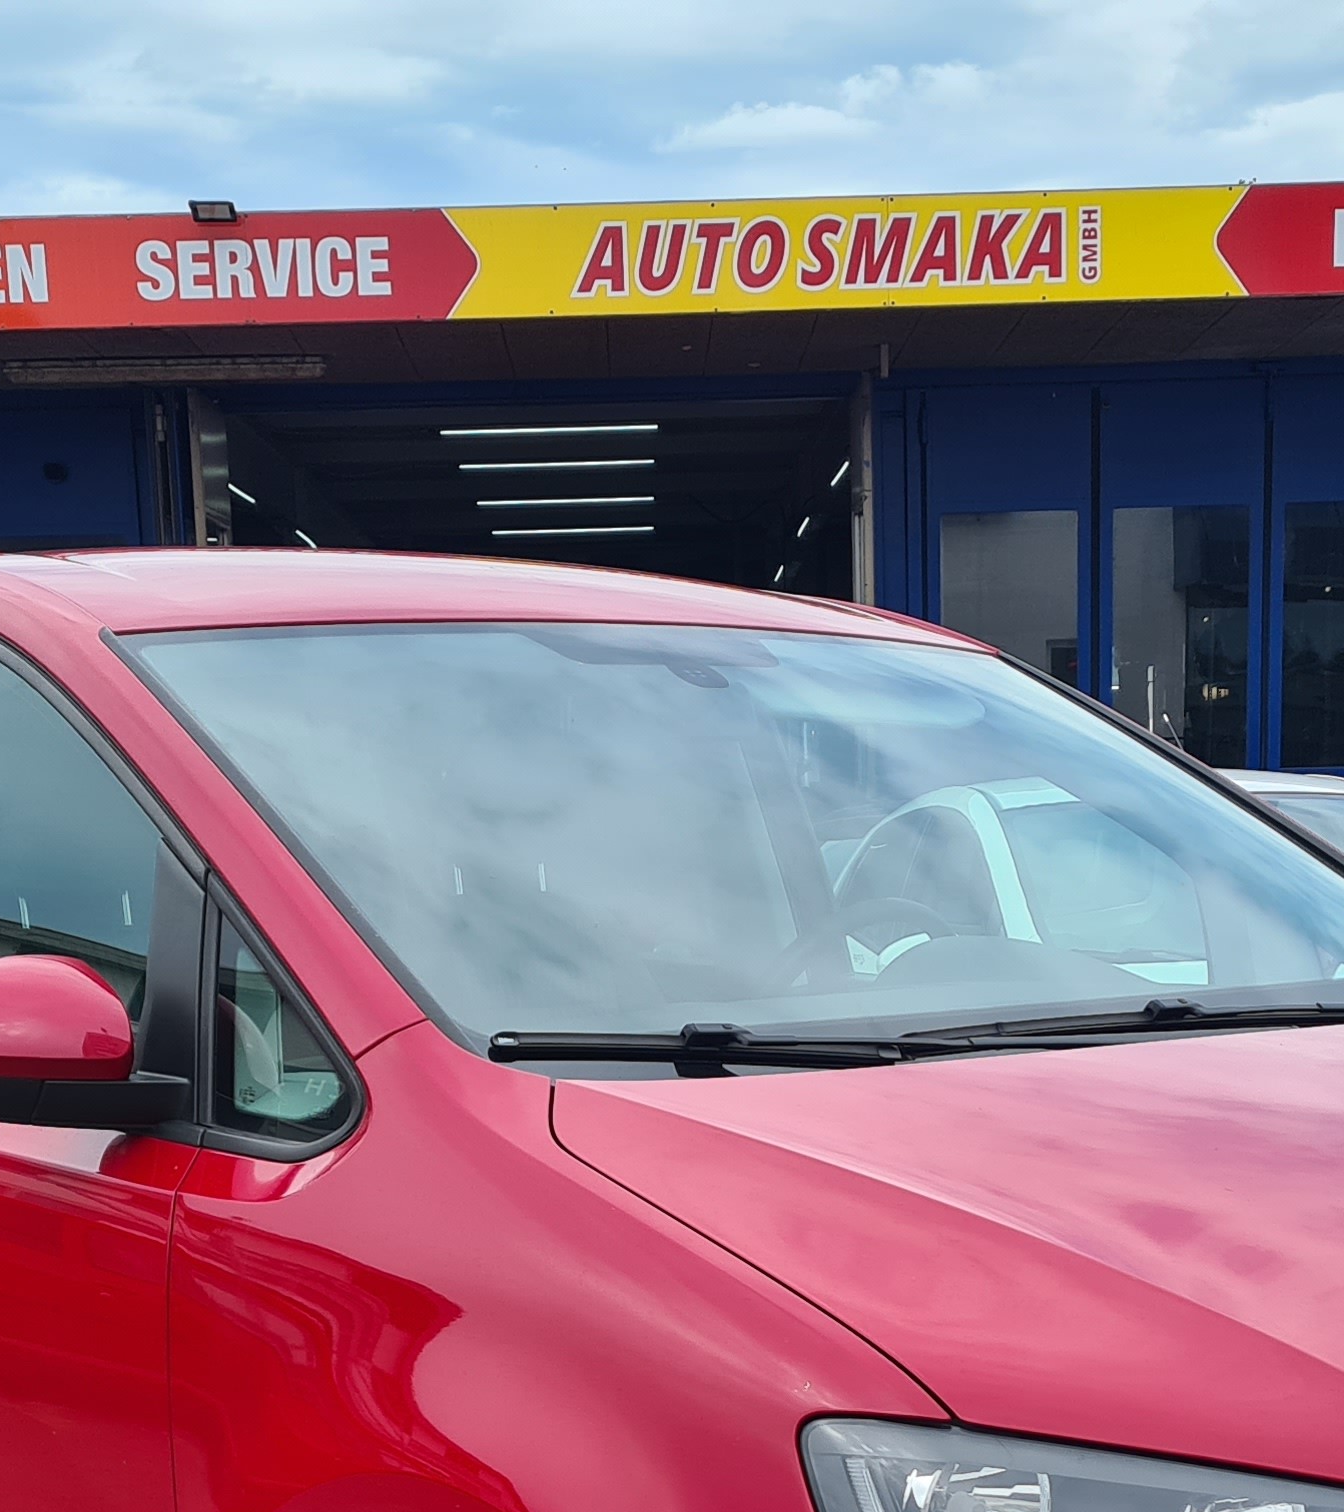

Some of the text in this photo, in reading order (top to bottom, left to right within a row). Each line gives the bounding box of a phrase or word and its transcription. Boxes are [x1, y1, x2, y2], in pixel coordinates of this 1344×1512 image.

[135, 236, 392, 301] SERVICE
[574, 210, 1063, 295] AUTO SMAKA
[1081, 208, 1098, 281] GMBH
